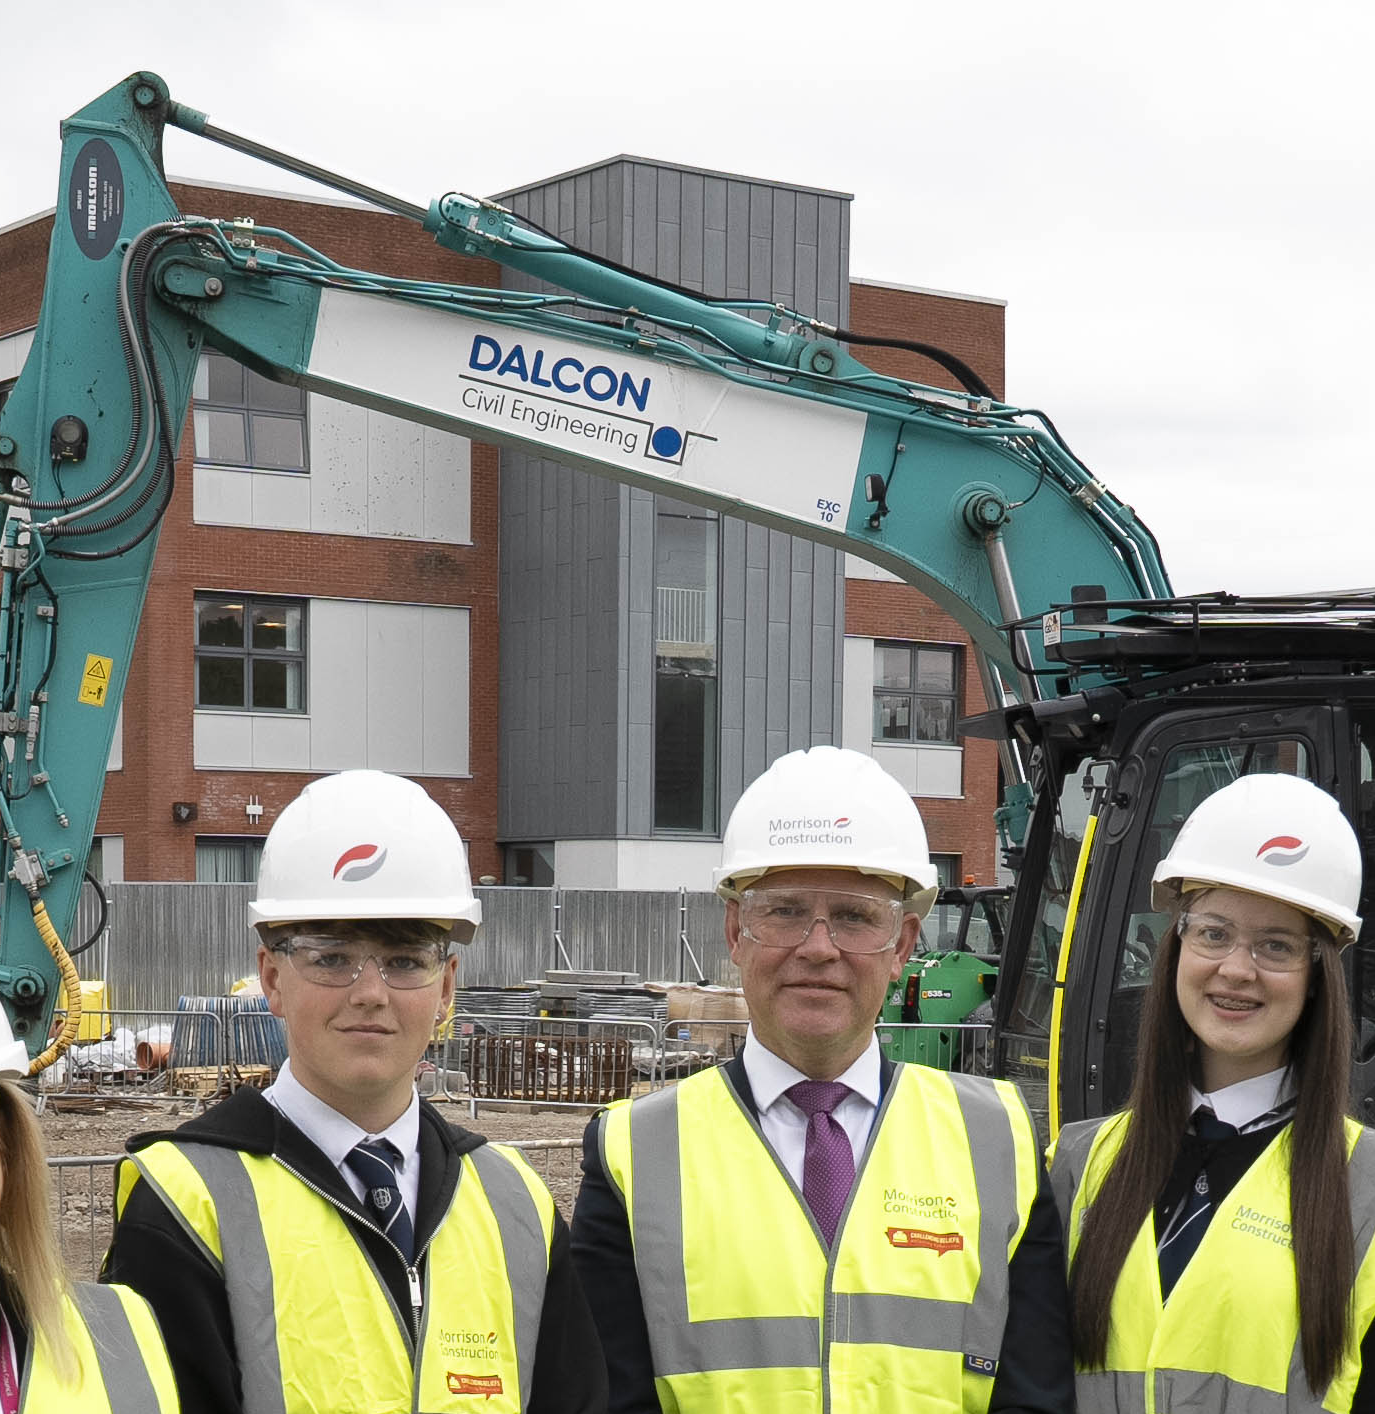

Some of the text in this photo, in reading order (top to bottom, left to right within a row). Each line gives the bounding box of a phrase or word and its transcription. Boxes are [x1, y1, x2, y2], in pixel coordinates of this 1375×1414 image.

[469, 334, 651, 412] DALCON
[461, 387, 638, 453] Civil Engineering
[816, 498, 841, 513] EXC
[820, 512, 834, 522] 10
[769, 816, 831, 832] Morrison
[768, 832, 852, 846] Construction
[1235, 1204, 1291, 1233] Morriso
[968, 1356, 993, 1371] LEO
